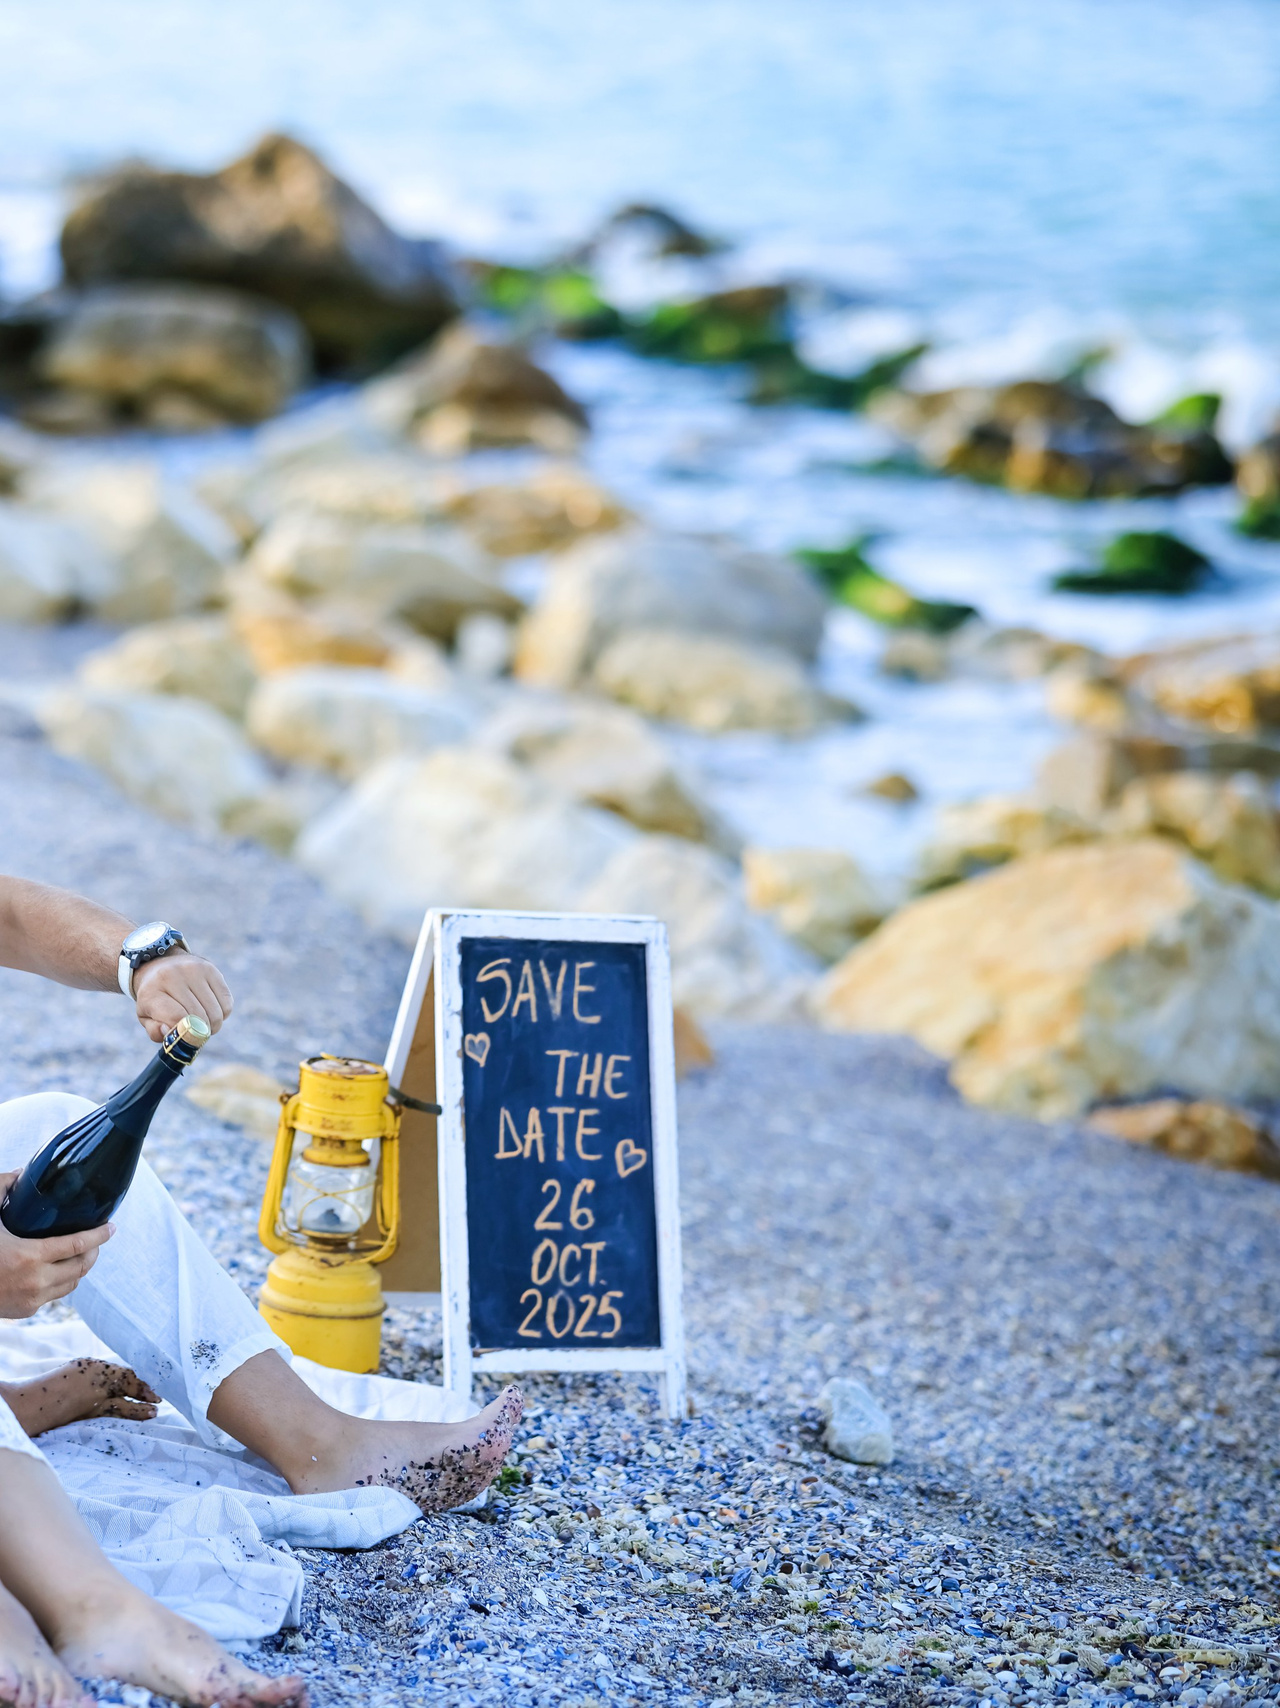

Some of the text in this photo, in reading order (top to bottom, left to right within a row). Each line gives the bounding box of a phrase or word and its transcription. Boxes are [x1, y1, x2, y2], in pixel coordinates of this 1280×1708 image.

[476, 957, 602, 1024] SAVE
[545, 1049, 631, 1099] THE
[494, 1106, 603, 1163] DATE
[533, 1178, 596, 1231] 26
[517, 1288, 624, 1339] 2025
